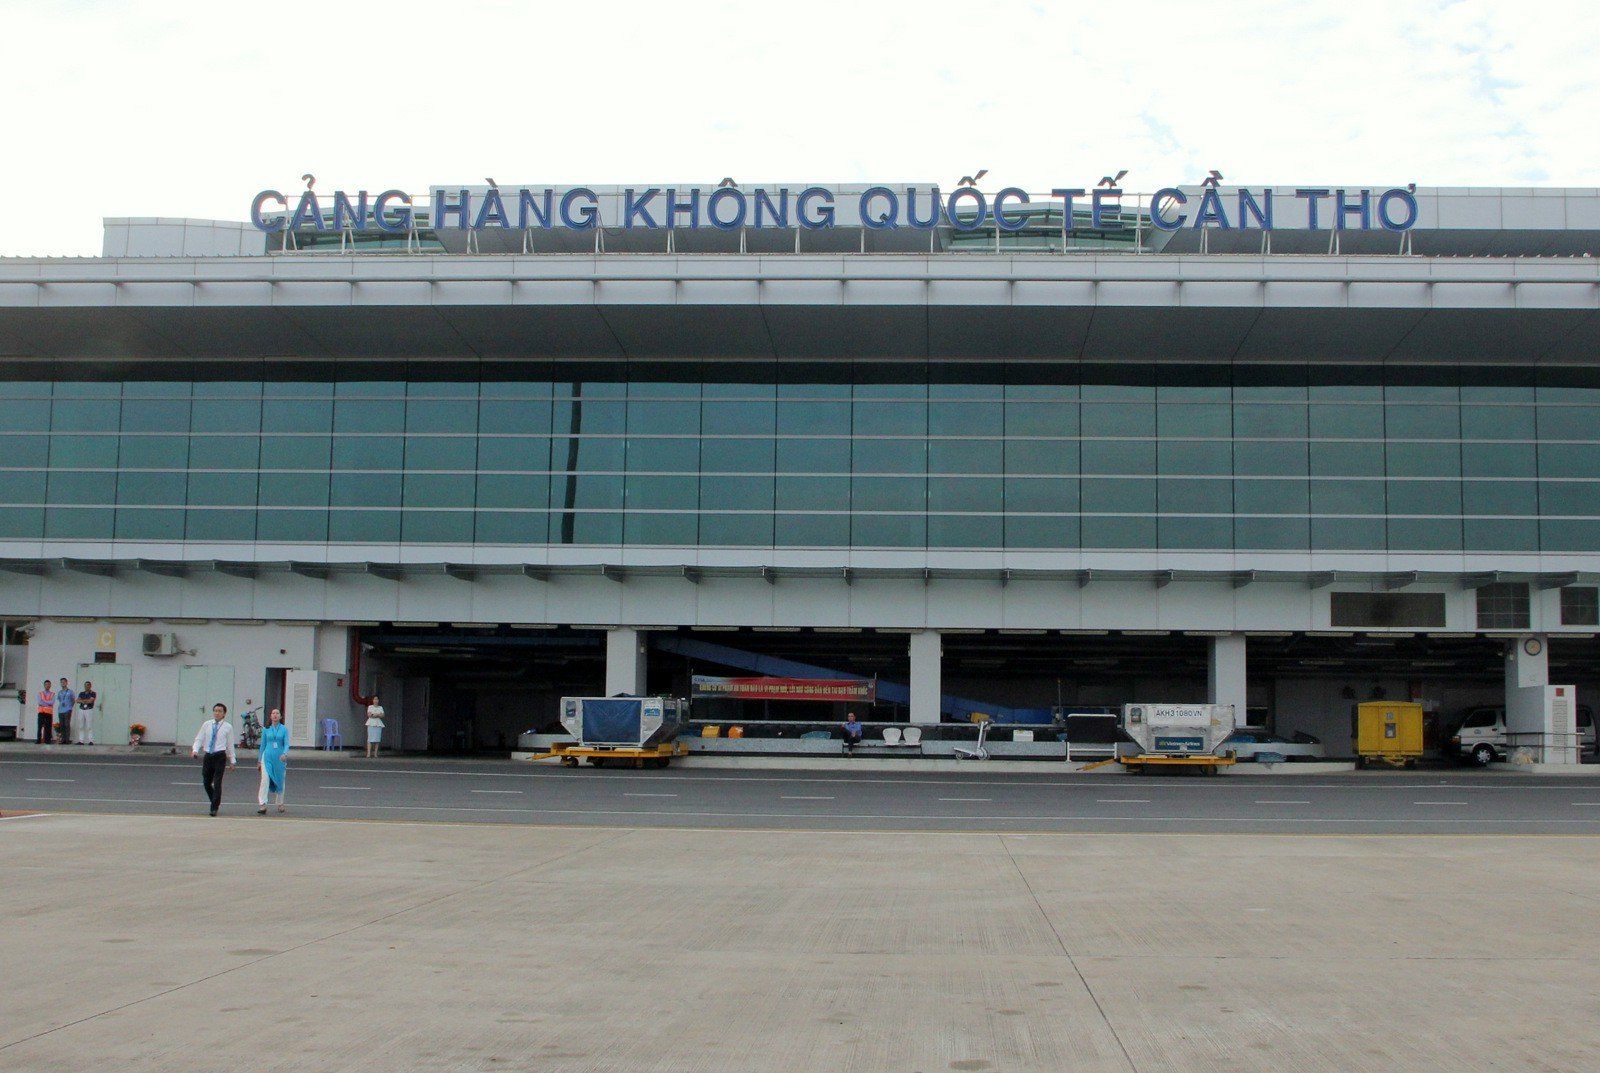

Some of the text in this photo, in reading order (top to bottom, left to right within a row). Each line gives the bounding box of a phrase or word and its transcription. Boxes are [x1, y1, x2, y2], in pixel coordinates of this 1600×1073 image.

[251, 169, 1420, 233] CẢNG HÀNG KHÔNG QUỐC TẾ CẦN THƠ
